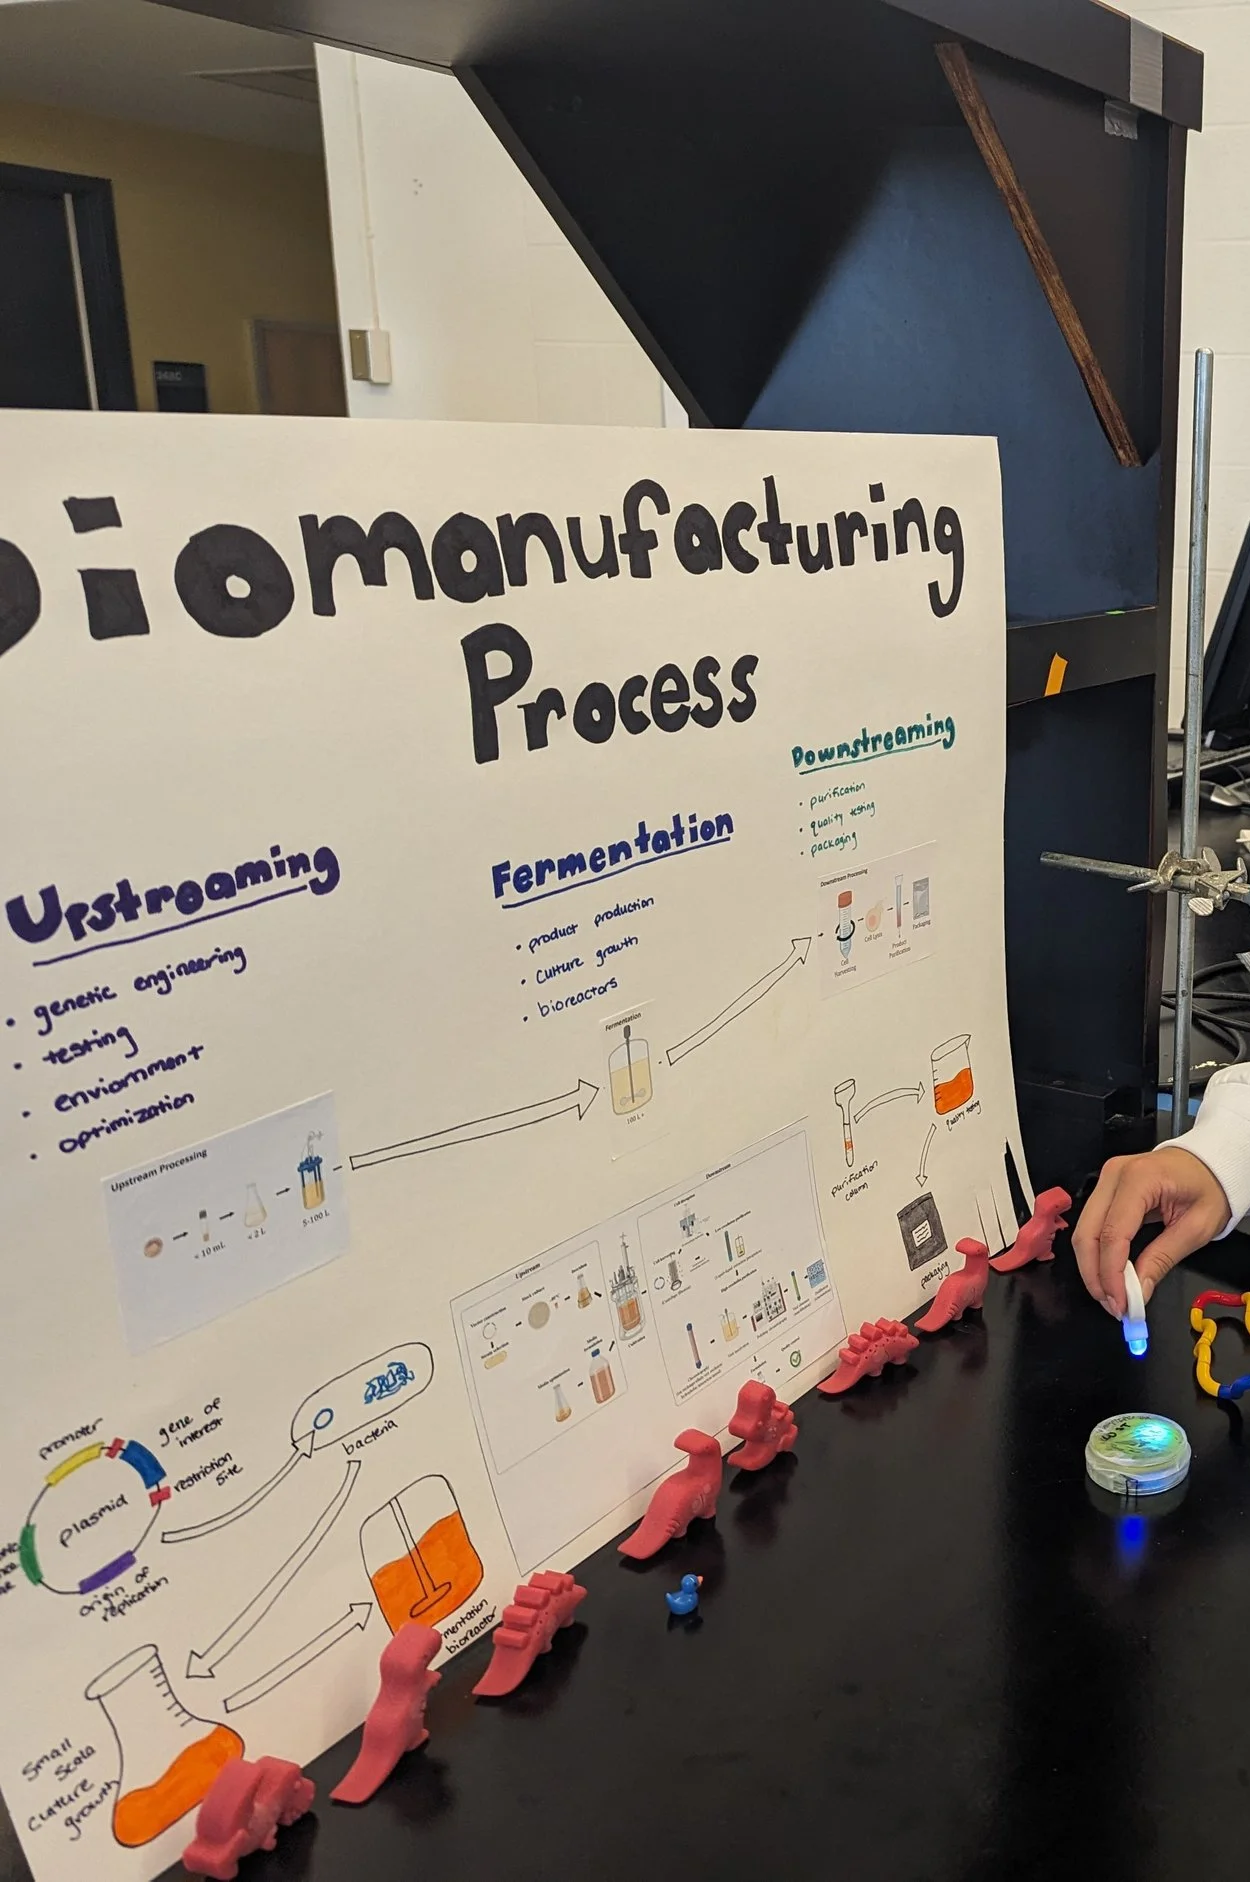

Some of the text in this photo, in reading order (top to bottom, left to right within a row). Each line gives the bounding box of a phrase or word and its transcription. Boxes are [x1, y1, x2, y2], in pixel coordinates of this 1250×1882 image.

[461, 622, 758, 763] Process
[792, 713, 955, 768] Downstreaming
[810, 782, 865, 810] purification
[810, 801, 875, 837] quality testing
[491, 813, 734, 898] Fermentation
[810, 831, 857, 857] packaging
[5, 845, 340, 943] Upstreaming
[528, 897, 654, 954] product production
[596, 935, 638, 967] growth
[34, 947, 247, 1036] genetic engineering
[538, 977, 618, 1018] bioreactors
[605, 1012, 641, 1031] Fermentation
[42, 1026, 139, 1066] testing
[59, 1093, 195, 1153] optimization
[111, 1149, 208, 1192] Upstream Processing
[831, 1160, 878, 1198] purification
[845, 1182, 868, 1201] column
[38, 1417, 103, 1460] promoter
[158, 1397, 221, 1448] gene of
[178, 1417, 223, 1448] interest
[342, 1419, 398, 1455] bacteria
[173, 1452, 233, 1492] restriction
[215, 1465, 243, 1487] site
[79, 1566, 150, 1617] origin of
[101, 1576, 169, 1622] replication
[441, 1599, 488, 1639] mentation
[445, 1605, 497, 1654] bioreactor
[64, 1780, 120, 1841] growth
